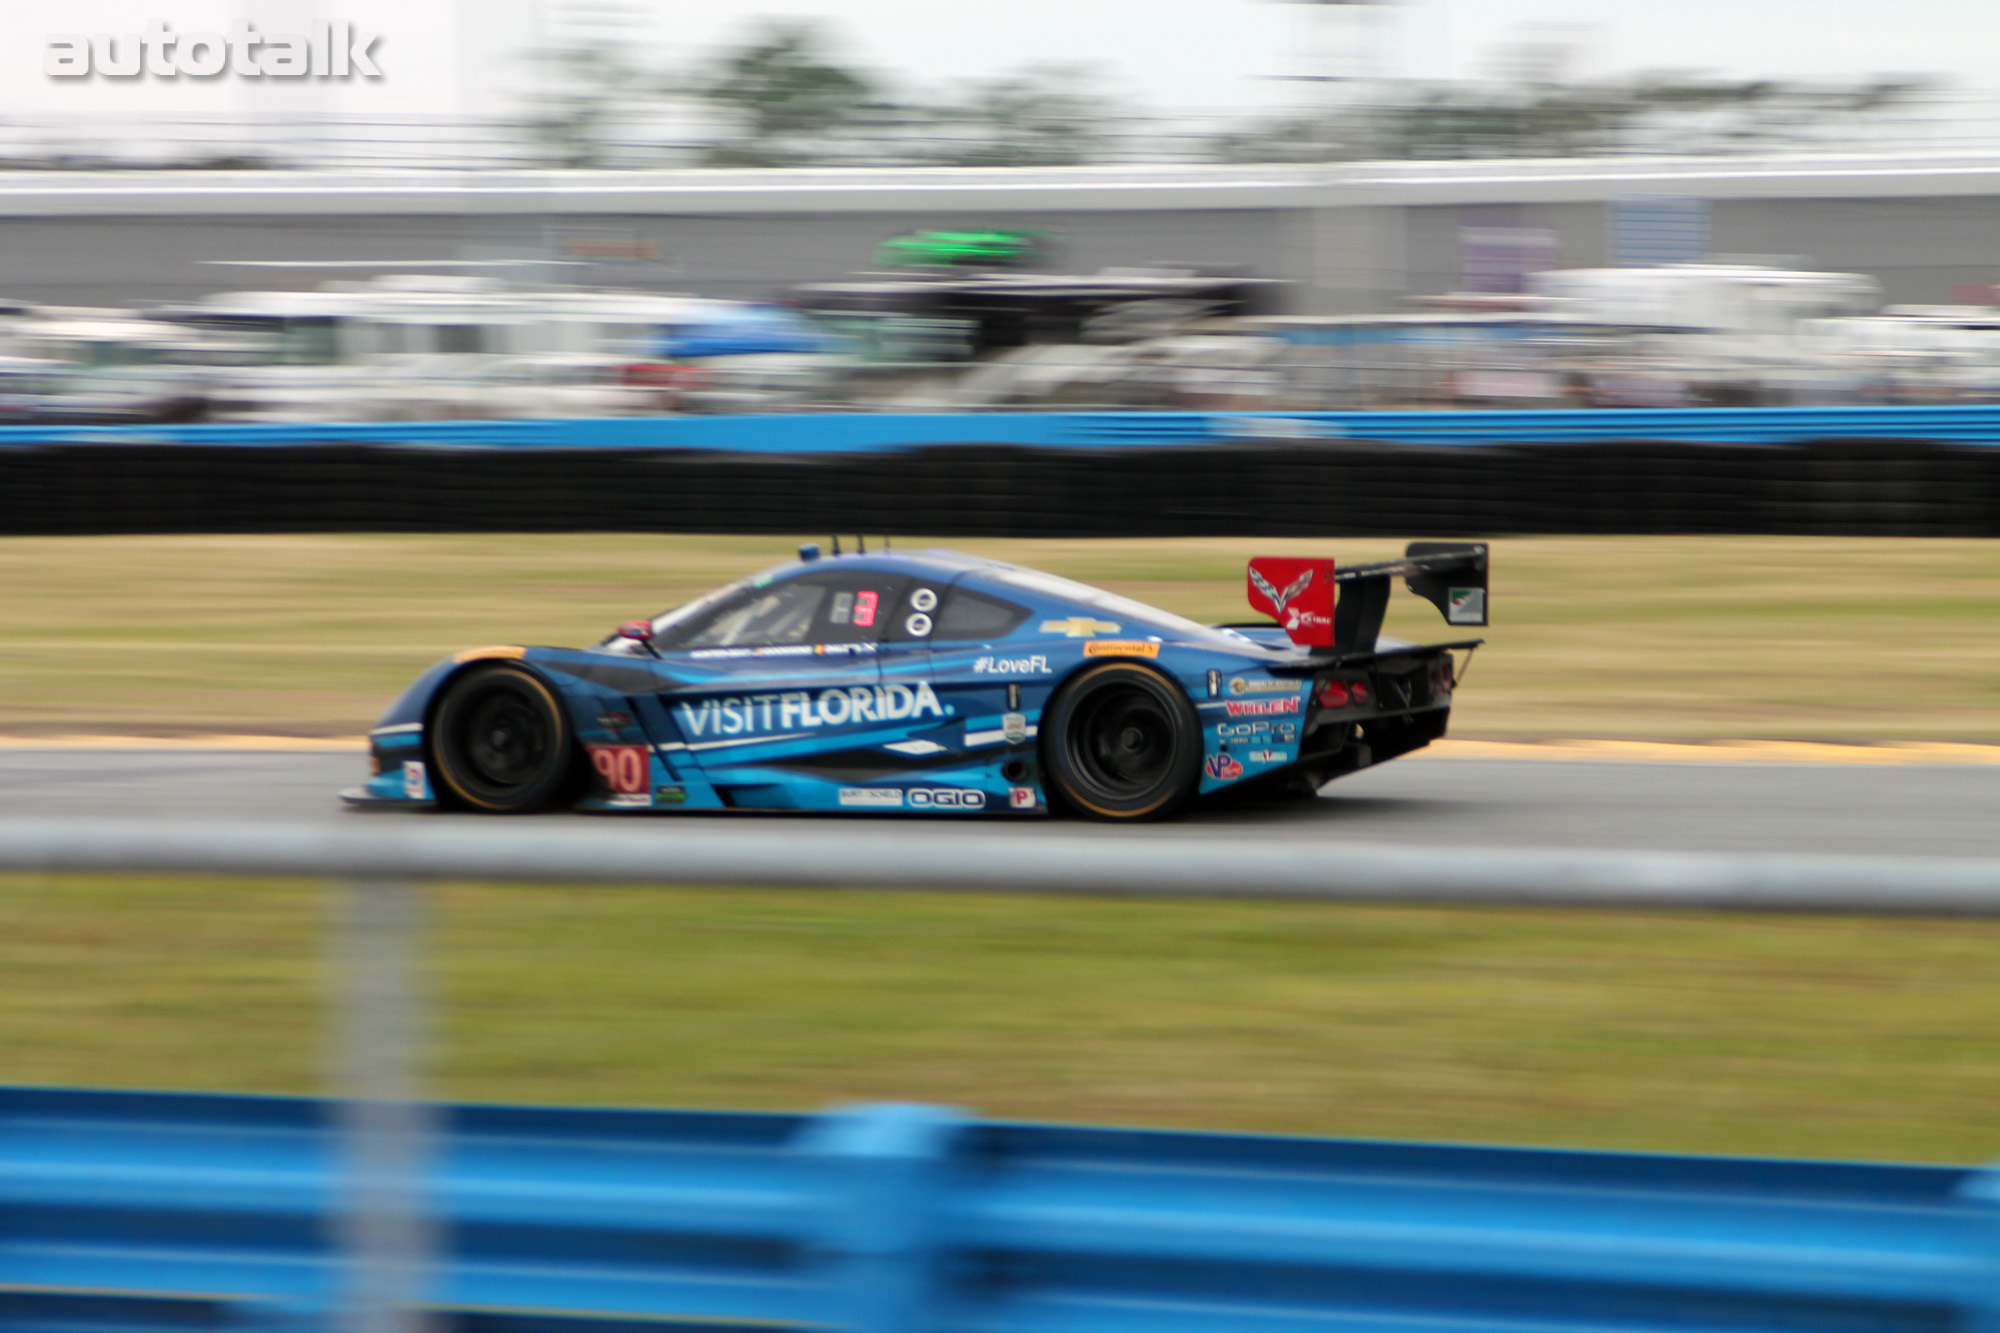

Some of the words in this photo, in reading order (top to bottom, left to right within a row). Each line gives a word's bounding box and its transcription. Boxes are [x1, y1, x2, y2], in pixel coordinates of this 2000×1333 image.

[973, 655, 1053, 675] #LoveFL
[1225, 696, 1301, 717] WHELEN
[592, 748, 643, 793] 90
[1207, 751, 1233, 779] VP
[908, 788, 985, 809] OGIO
